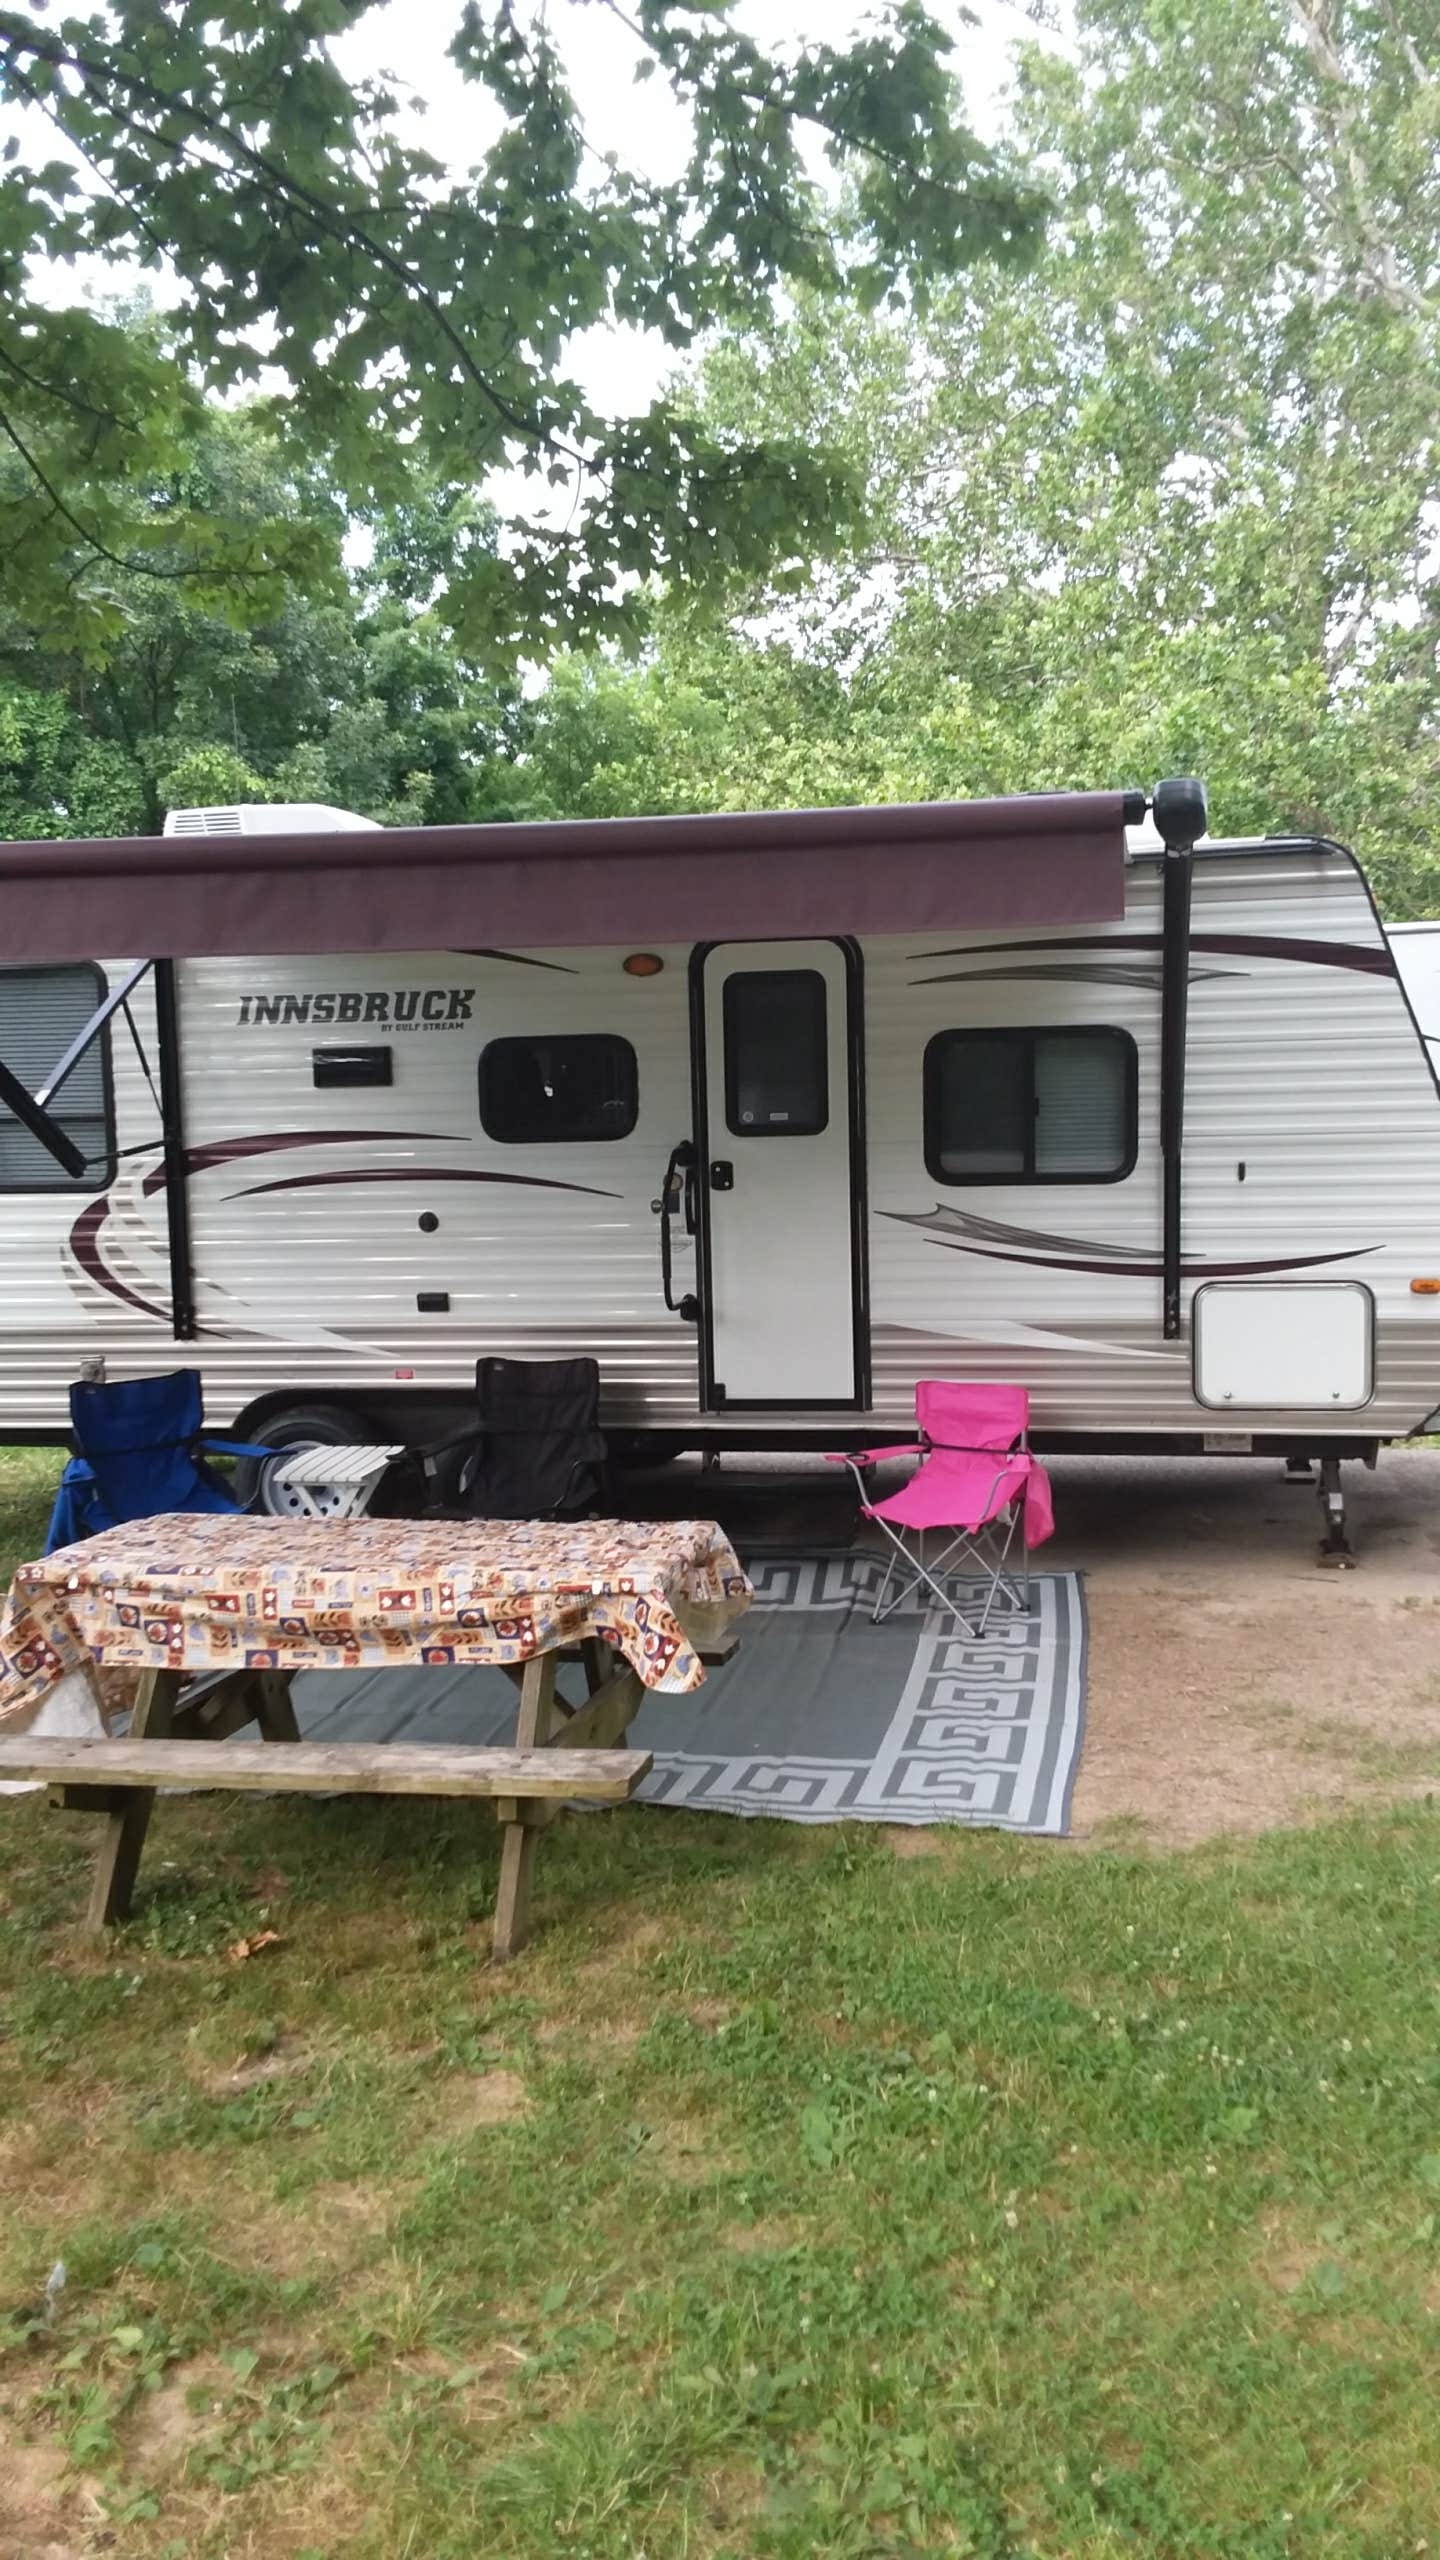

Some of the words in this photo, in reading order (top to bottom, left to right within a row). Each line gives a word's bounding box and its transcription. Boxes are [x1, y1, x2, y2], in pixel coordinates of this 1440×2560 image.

[237, 989, 476, 1025] INNSBRUCK
[381, 1023, 392, 1032] BY
[395, 1023, 420, 1032] GULF
[422, 1022, 464, 1031] STREAM
